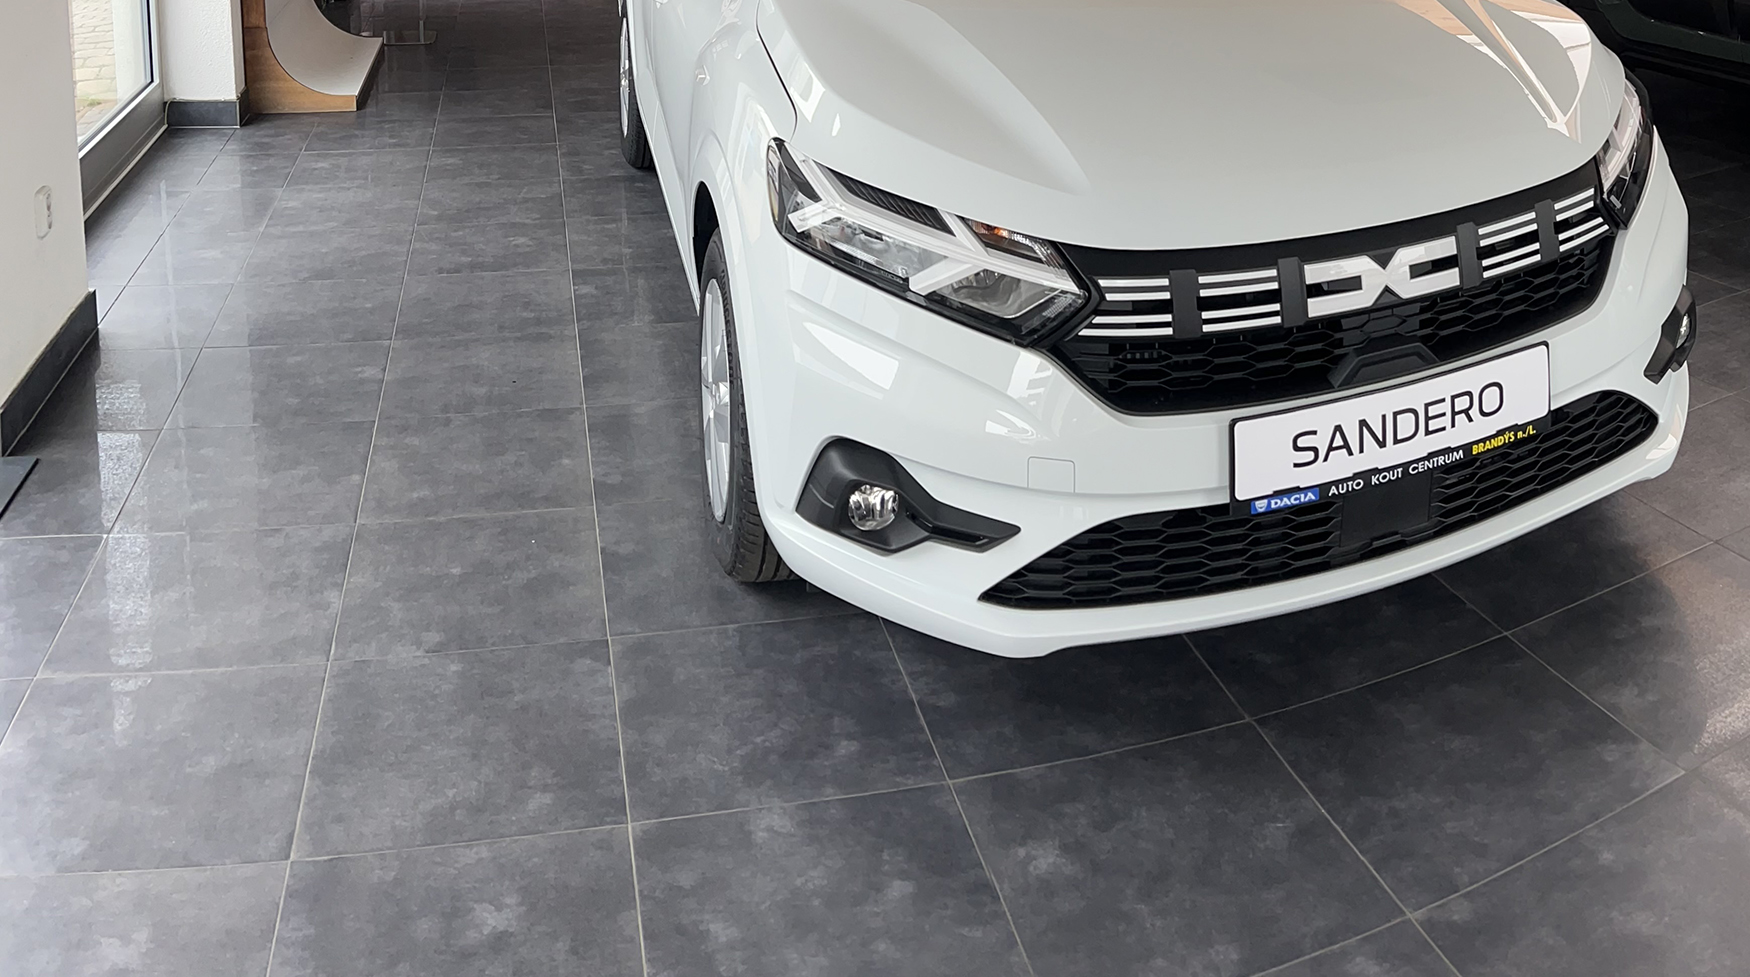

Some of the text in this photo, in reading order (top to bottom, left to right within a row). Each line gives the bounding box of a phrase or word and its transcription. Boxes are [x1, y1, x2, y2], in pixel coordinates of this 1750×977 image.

[1291, 381, 1505, 469] SANDERO
[1270, 491, 1316, 509] DACIA
[1328, 479, 1364, 497] AUTO
[1371, 467, 1404, 486] KOUT
[1408, 449, 1464, 475] CENTRUM
[1472, 430, 1515, 455] BRANDÝS
